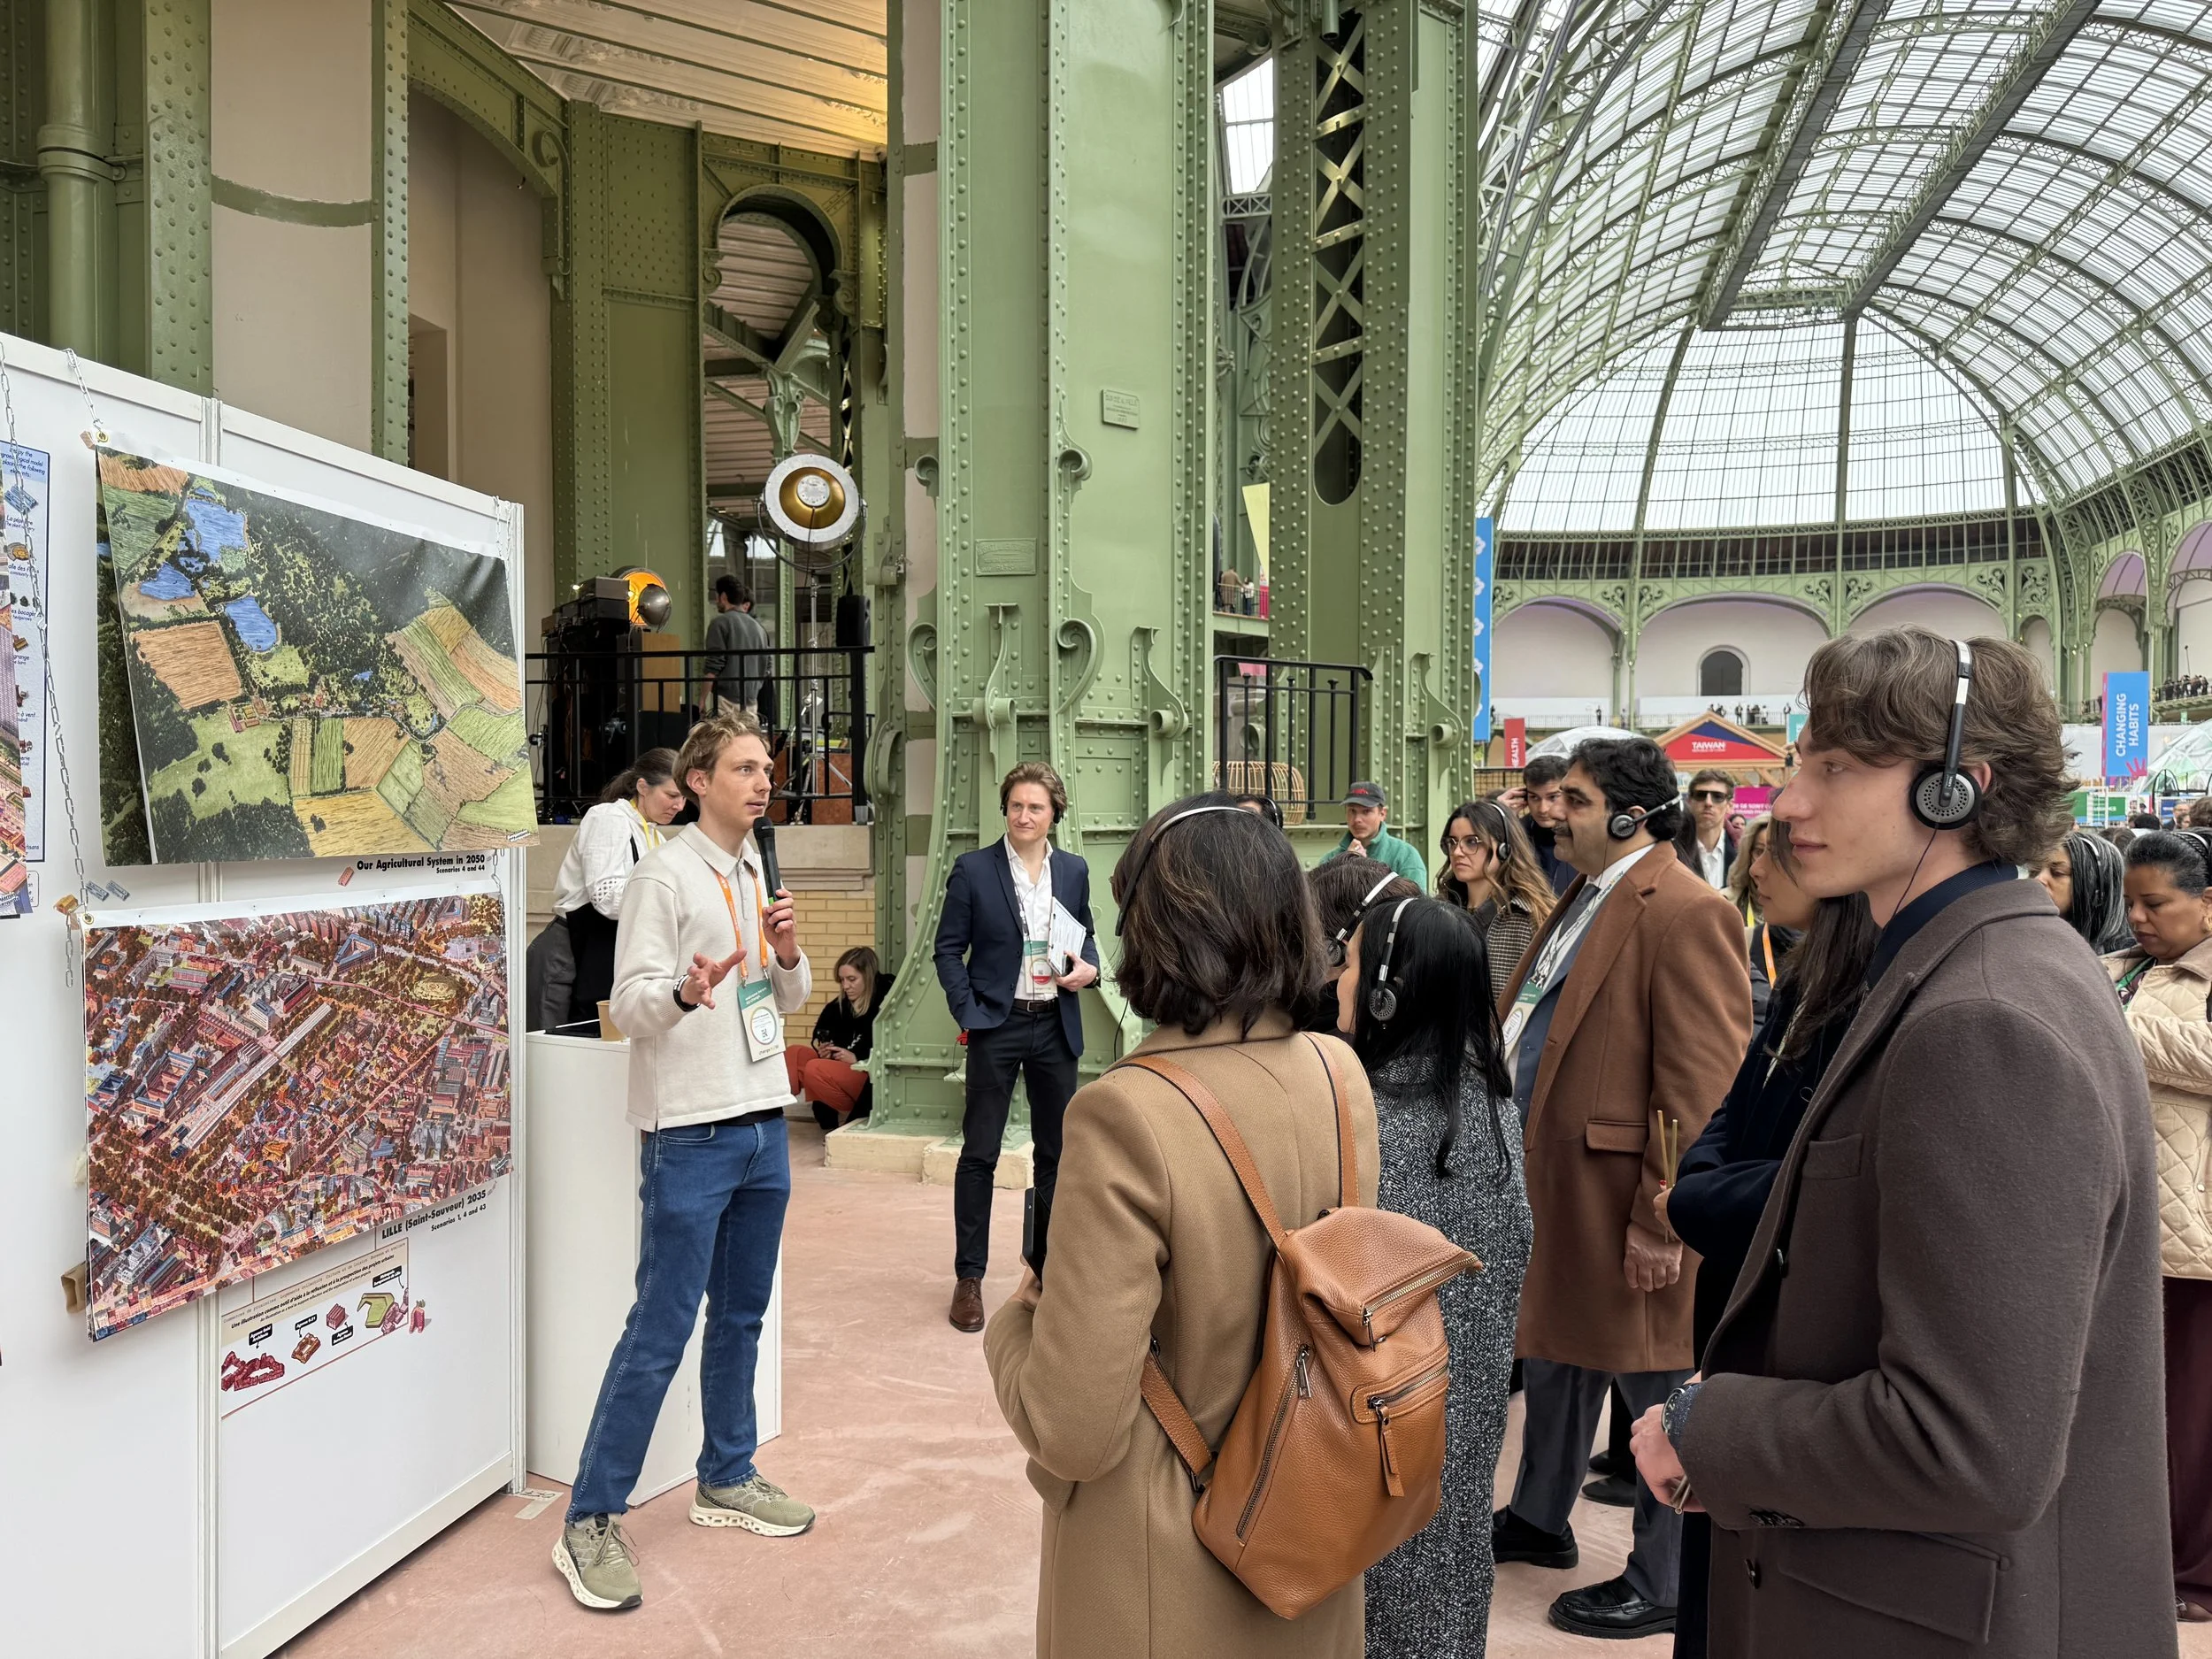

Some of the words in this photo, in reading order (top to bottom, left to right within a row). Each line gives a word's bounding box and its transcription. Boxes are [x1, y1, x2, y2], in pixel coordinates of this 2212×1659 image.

[27, 465, 45, 475] following
[2116, 694, 2126, 757] CHANGING
[2129, 703, 2139, 747] HABITS
[357, 860, 373, 870] Our
[376, 856, 424, 872] Agricultural
[426, 856, 453, 868] System
[457, 856, 463, 864] in
[466, 855, 485, 864] 2050
[382, 1223, 403, 1239] LILLE
[405, 1198, 465, 1231] (Saint-Sauveur)
[467, 1190, 486, 1204] 2035
[431, 1217, 455, 1231] Scenarios
[241, 1310, 264, 1324] illustration
[265, 1304, 279, 1314] comme
